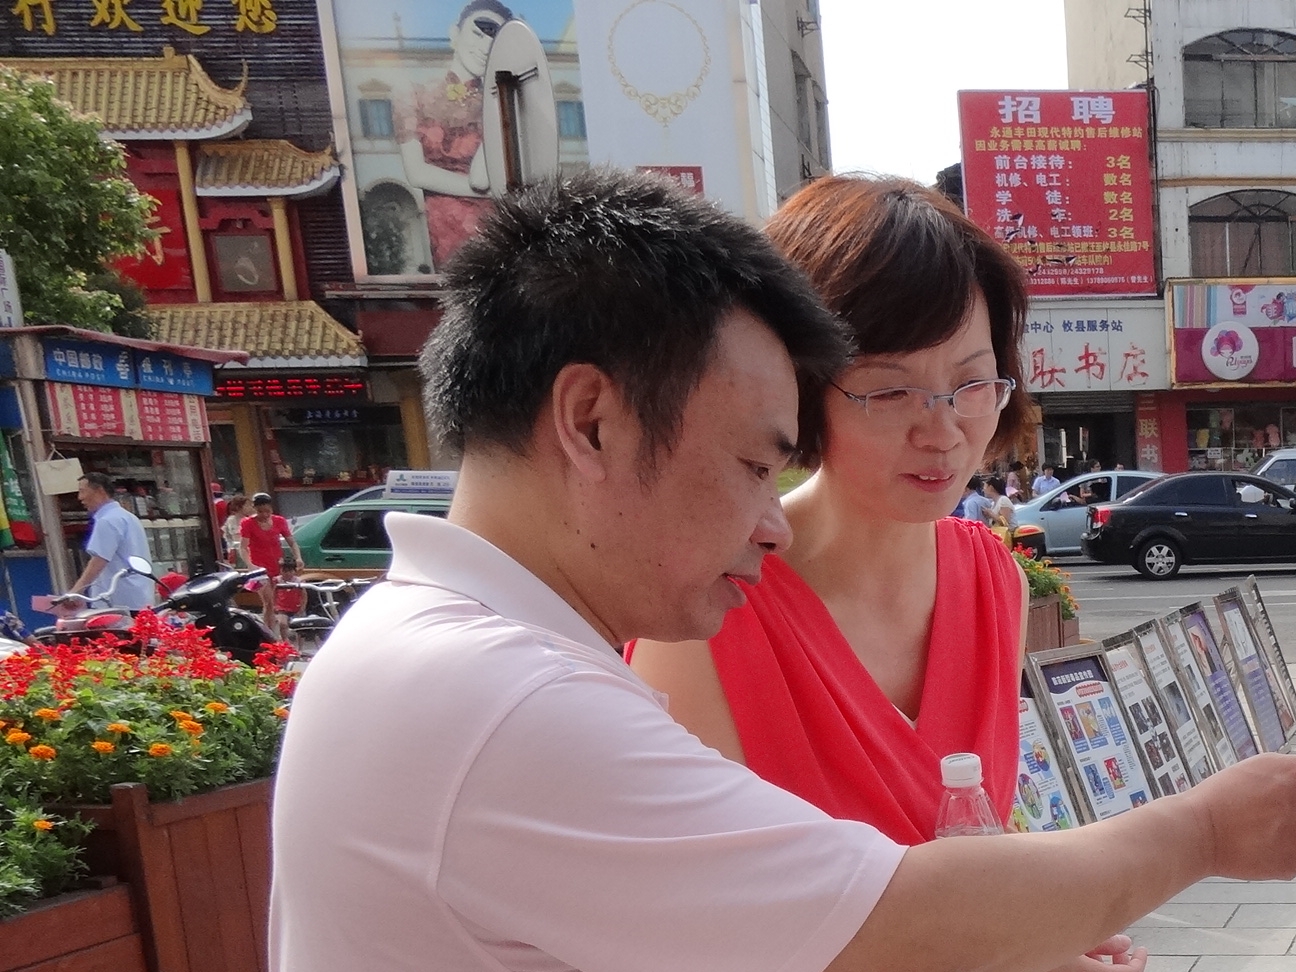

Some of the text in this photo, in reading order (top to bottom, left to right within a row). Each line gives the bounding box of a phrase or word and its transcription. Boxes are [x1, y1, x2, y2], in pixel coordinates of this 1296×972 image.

[998, 95, 1116, 124] 招聘
[990, 126, 1143, 139] 永通丰田现代特约售后维修站
[1105, 154, 1132, 169] 3名
[1103, 172, 1132, 187] 数名
[1103, 190, 1133, 205] 数名
[1108, 208, 1134, 222] 2名
[1107, 226, 1135, 240] 3名
[1062, 319, 1124, 333] 攸县服务站
